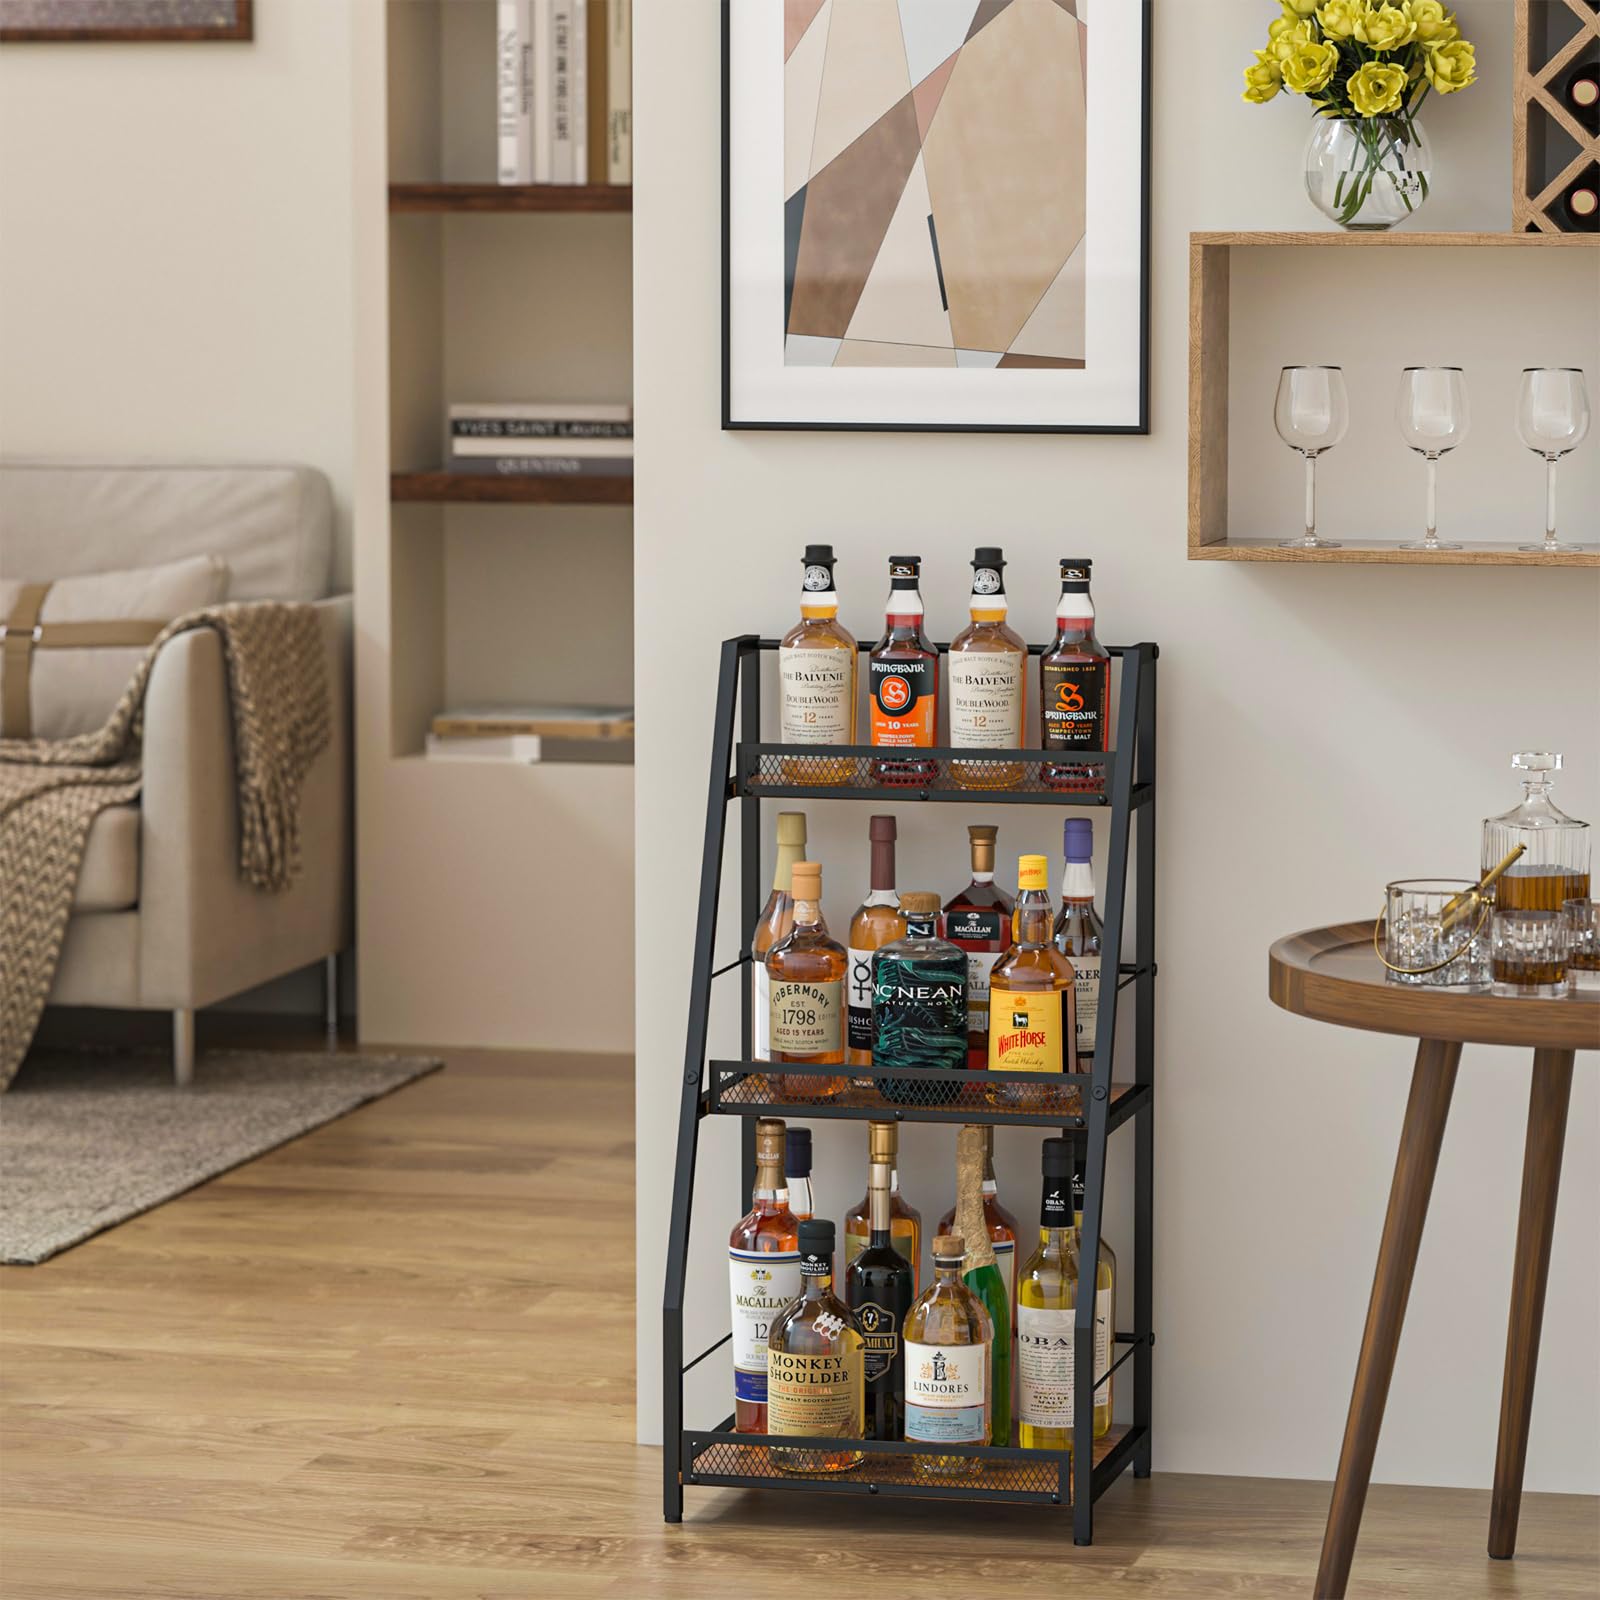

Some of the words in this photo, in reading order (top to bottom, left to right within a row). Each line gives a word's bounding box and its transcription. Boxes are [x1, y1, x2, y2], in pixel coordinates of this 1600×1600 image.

[796, 672, 843, 681] BALVENIE
[965, 675, 1014, 685] BALVENIE
[804, 712, 816, 723] 12
[1045, 710, 1098, 720] SPRINGBANK
[888, 721, 900, 729] 10
[973, 716, 986, 727] 12
[1075, 970, 1100, 979] KER
[773, 984, 830, 1008] TOBERMORY
[783, 1009, 816, 1025] 1798
[776, 1028, 790, 1036] AGED
[802, 1028, 824, 1036] YEARS
[998, 1033, 1019, 1058] WHITE
[1020, 1030, 1046, 1048] HORSE
[753, 1286, 767, 1296] The
[755, 1323, 768, 1339] 12
[865, 1338, 893, 1348] MIUM
[1021, 1334, 1069, 1346] OBA
[773, 1353, 843, 1369] MONKEY
[770, 1367, 849, 1384] SHOULDER
[914, 1381, 969, 1393] LINDORES
